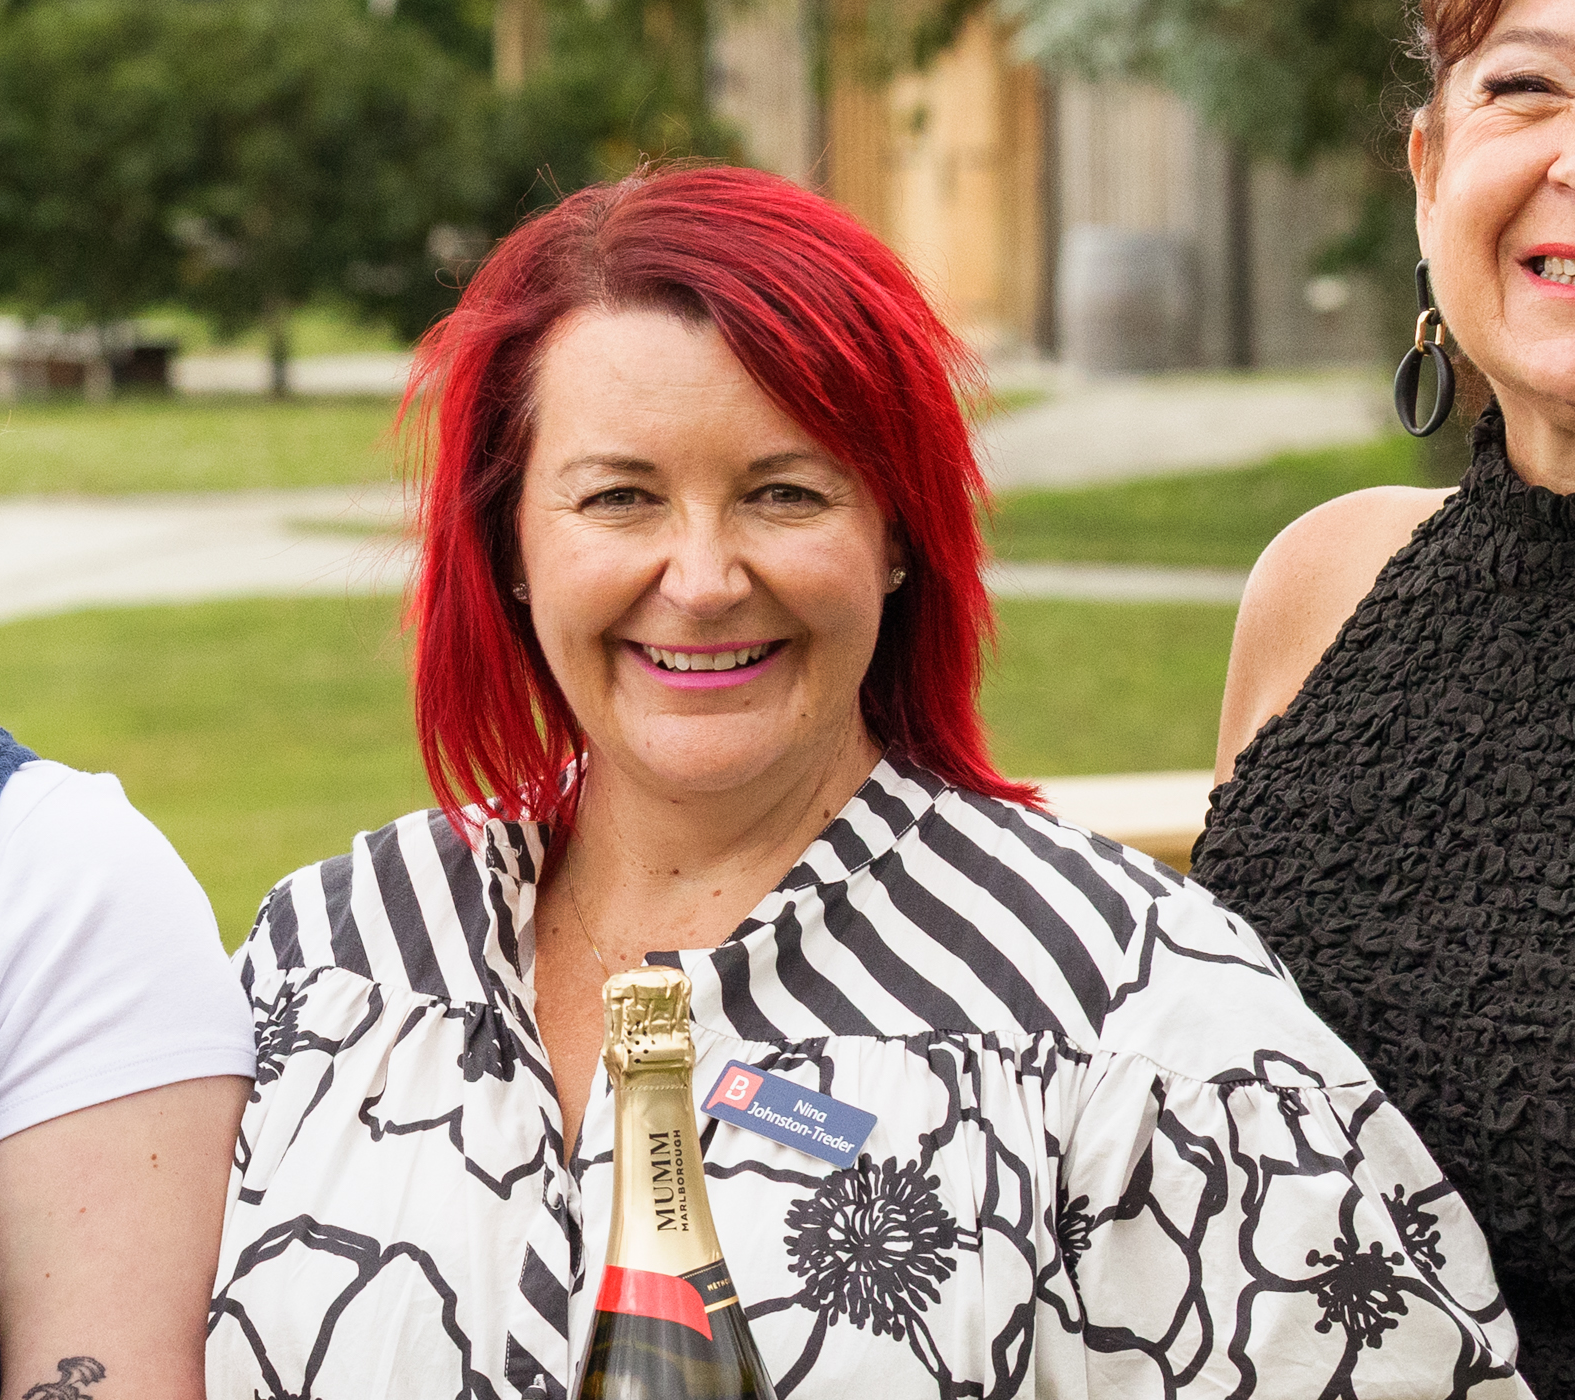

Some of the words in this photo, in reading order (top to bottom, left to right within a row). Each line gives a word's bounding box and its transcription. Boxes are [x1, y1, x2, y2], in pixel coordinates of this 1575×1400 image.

[747, 1101, 856, 1153] Johnston-Treder
[792, 1099, 828, 1123] Nina
[649, 1132, 677, 1231] MUMM
[673, 1129, 689, 1232] MARLBOROUGH
